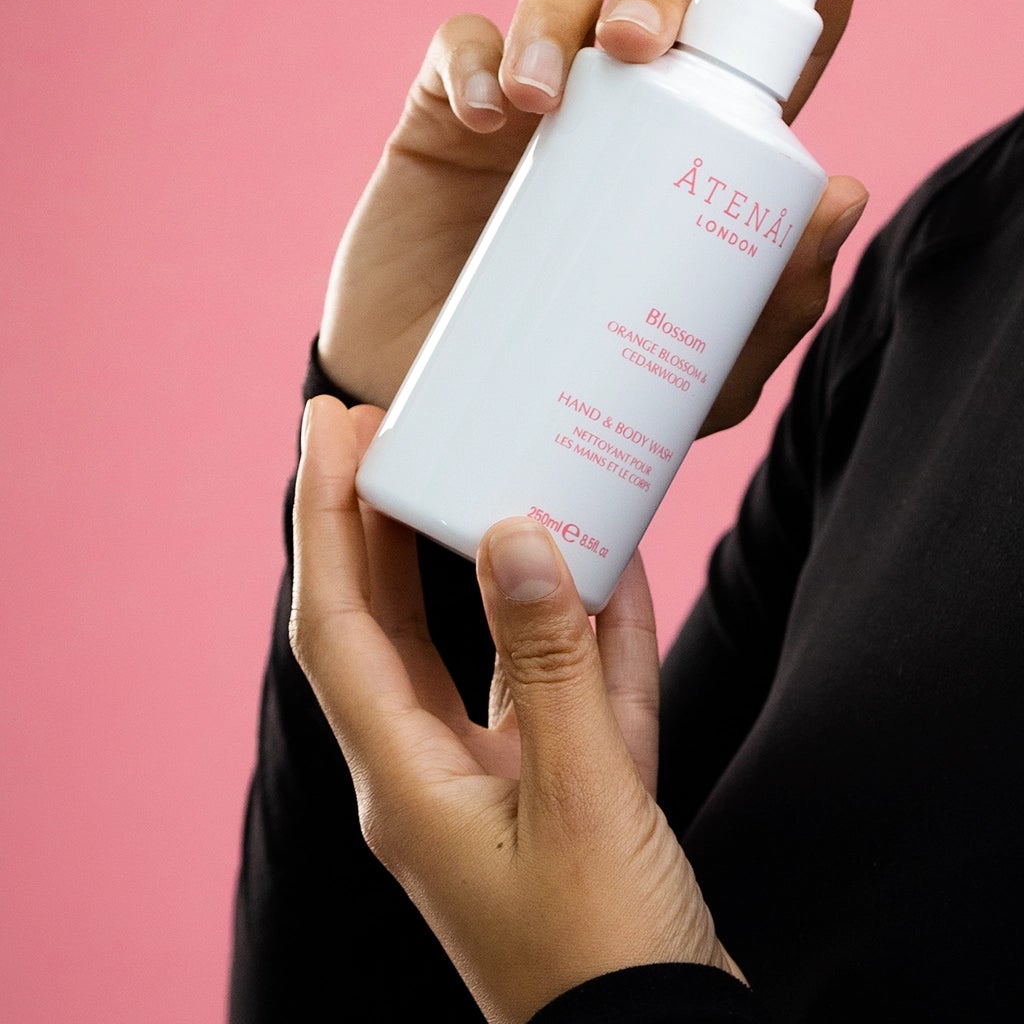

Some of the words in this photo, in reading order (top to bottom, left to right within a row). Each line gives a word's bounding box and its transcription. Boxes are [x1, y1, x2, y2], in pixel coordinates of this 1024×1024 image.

[673, 157, 793, 248] ÅTENÅI
[696, 214, 758, 257] LONDON
[607, 321, 659, 354] ORANGE
[658, 348, 702, 381] BLOSSOM
[645, 308, 706, 354] Blossom
[622, 347, 690, 392] CEDARWOOD
[557, 391, 601, 421] HAND
[602, 416, 613, 428] &
[615, 422, 649, 447] BODY
[648, 440, 673, 463] WASH
[572, 426, 631, 463] NETTOYANT
[630, 457, 652, 475] POUR
[554, 433, 574, 449] LES
[573, 444, 607, 467] MAINS
[607, 461, 619, 473] ET
[618, 468, 629, 480] LE
[628, 474, 651, 492] CORPS
[527, 506, 563, 532] 250ml
